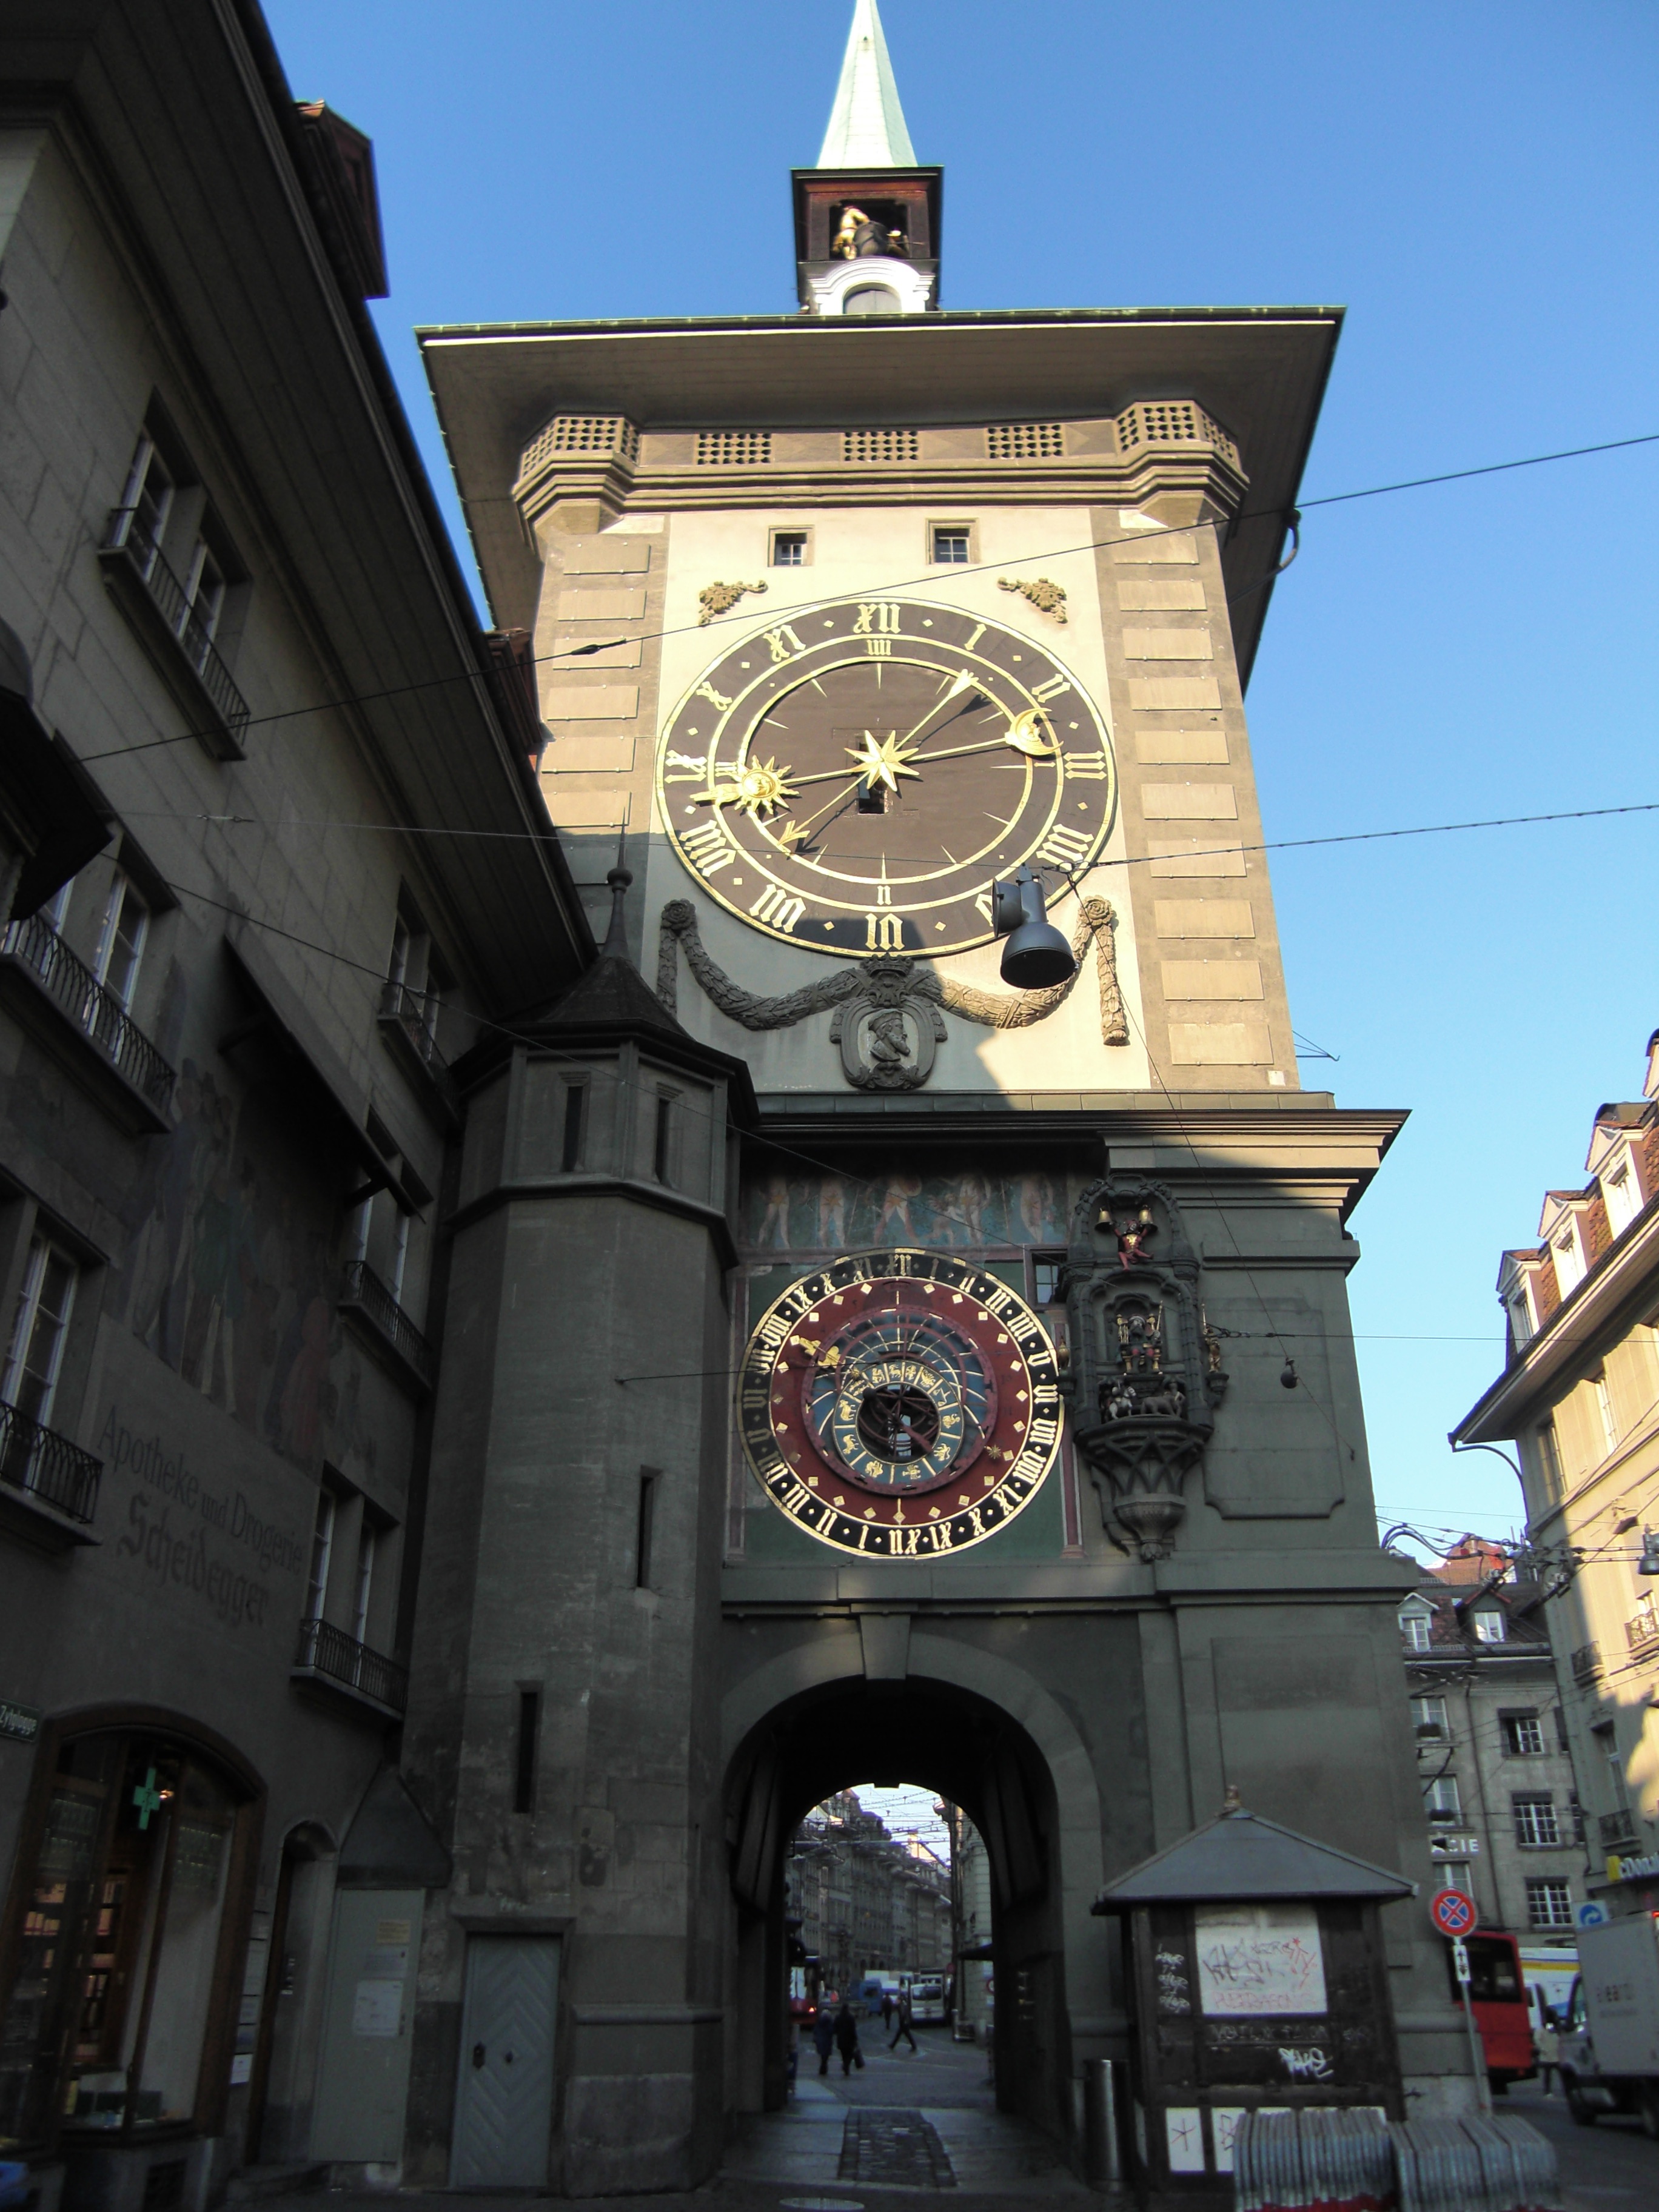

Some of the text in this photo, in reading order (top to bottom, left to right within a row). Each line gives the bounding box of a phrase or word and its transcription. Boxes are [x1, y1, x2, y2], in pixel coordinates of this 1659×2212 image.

[853, 603, 901, 634] XII
[763, 625, 806, 662] XI
[965, 623, 987, 651] I
[696, 680, 732, 711] X
[1031, 673, 1071, 703] II
[1064, 750, 1107, 780] III
[985, 1288, 1011, 1314] III
[97, 1404, 304, 1575] Apotheke und Drogerie
[117, 1491, 270, 1628] Scheidegger
